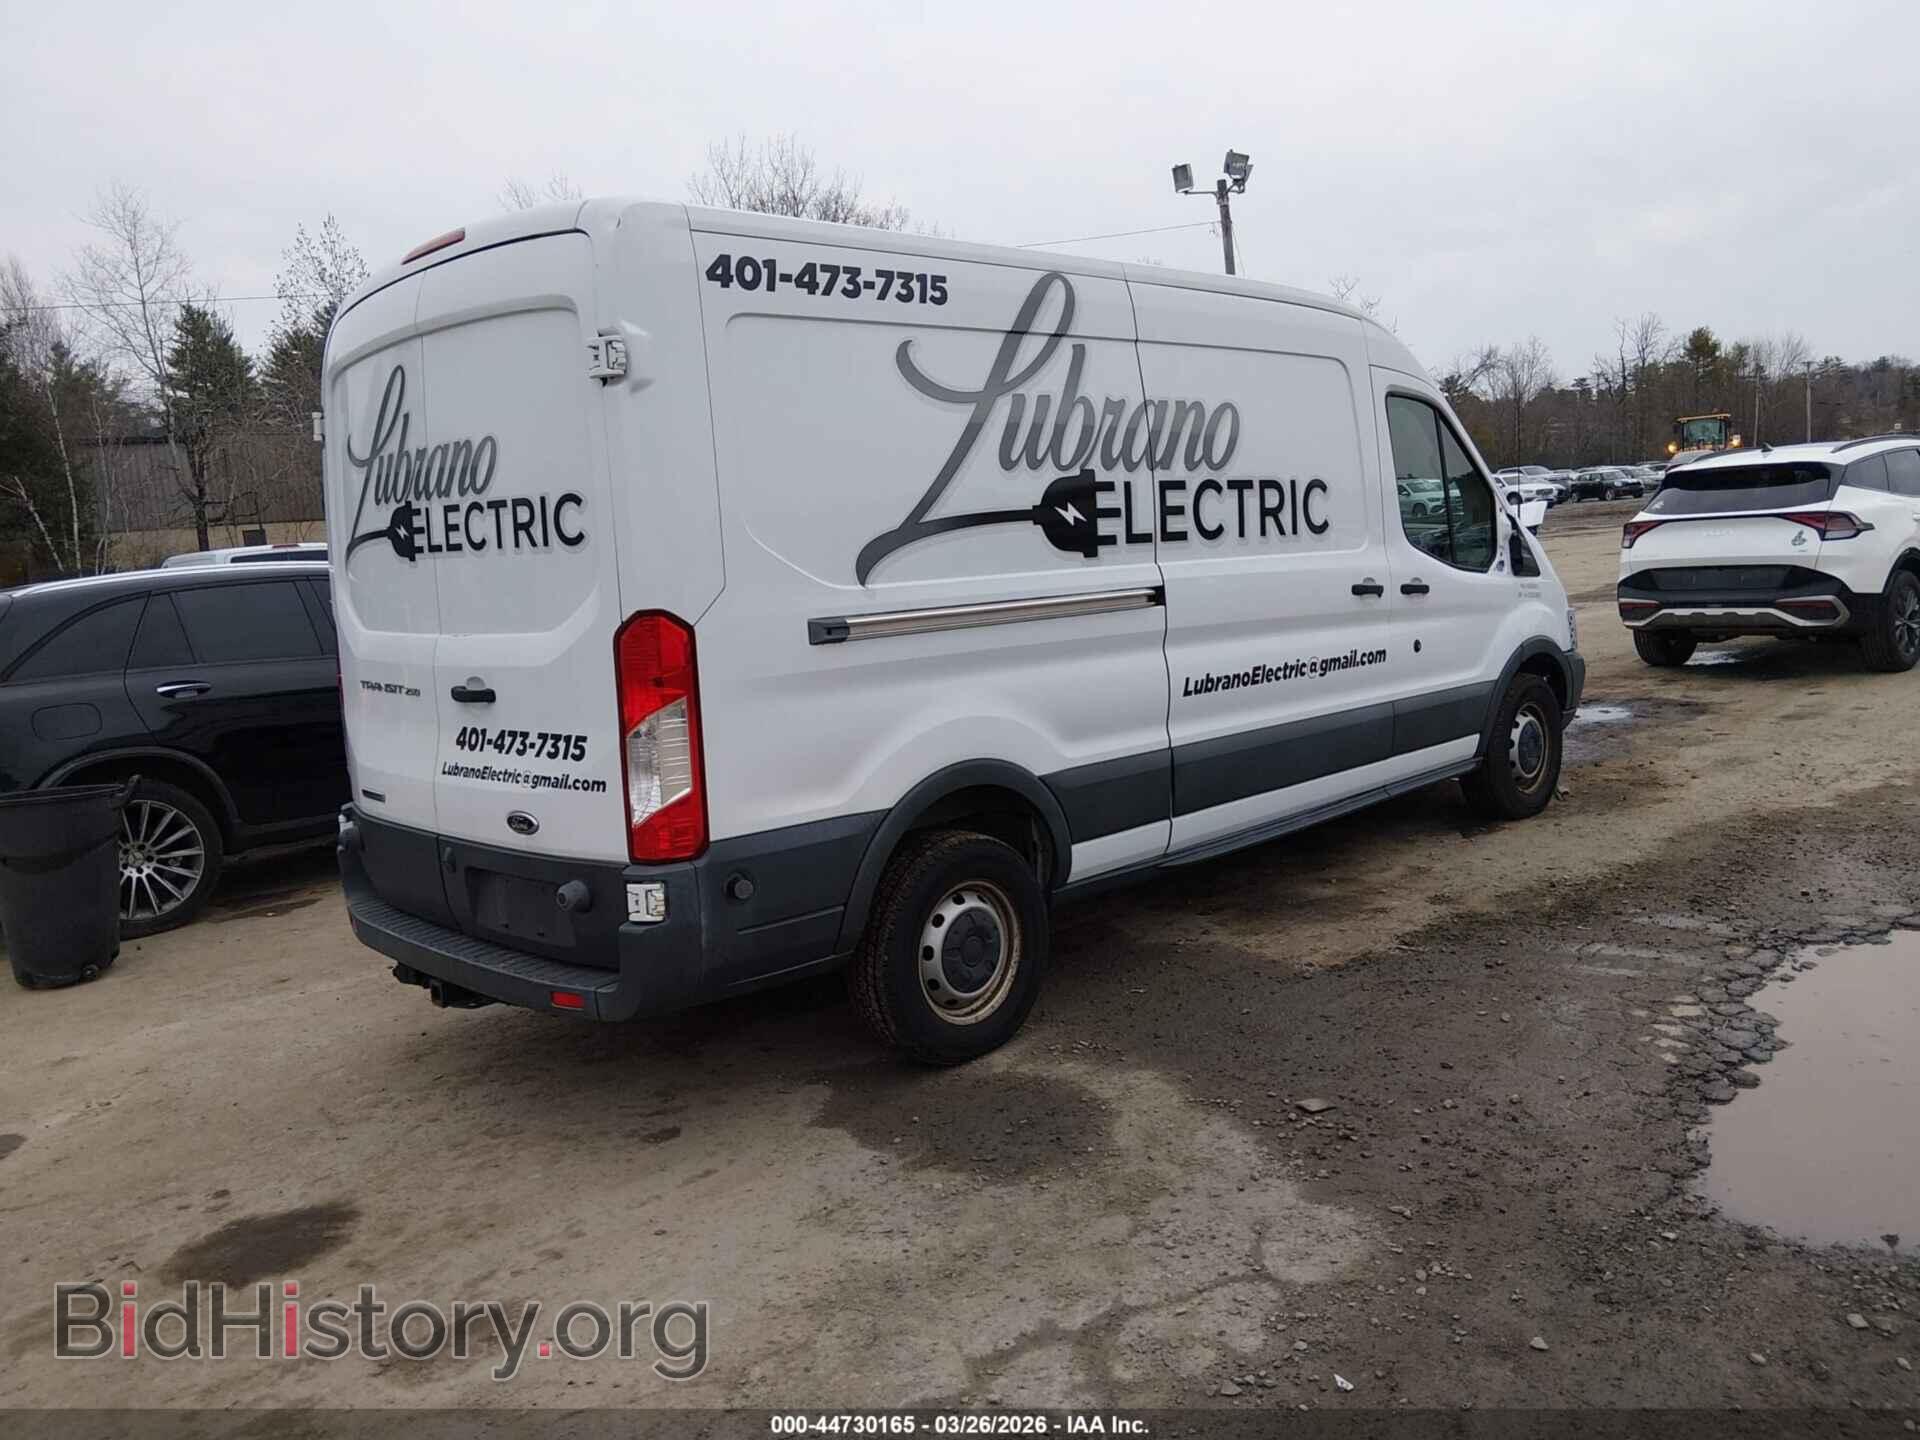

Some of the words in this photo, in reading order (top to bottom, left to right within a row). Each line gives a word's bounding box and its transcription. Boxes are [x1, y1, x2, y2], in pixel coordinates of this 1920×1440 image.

[704, 253, 949, 307] 401-473-7315
[856, 271, 1241, 588] Lubrano
[345, 364, 498, 580] Lubrano
[411, 492, 586, 554] ELECTRIC
[1096, 477, 1331, 546] ELECTRIC
[360, 680, 405, 694] TRASIT
[1182, 647, 1388, 698] LubranoElectric@gmail.com
[455, 725, 589, 762] 401-473-7315
[441, 760, 608, 793] LubranoElectric@gmail.com
